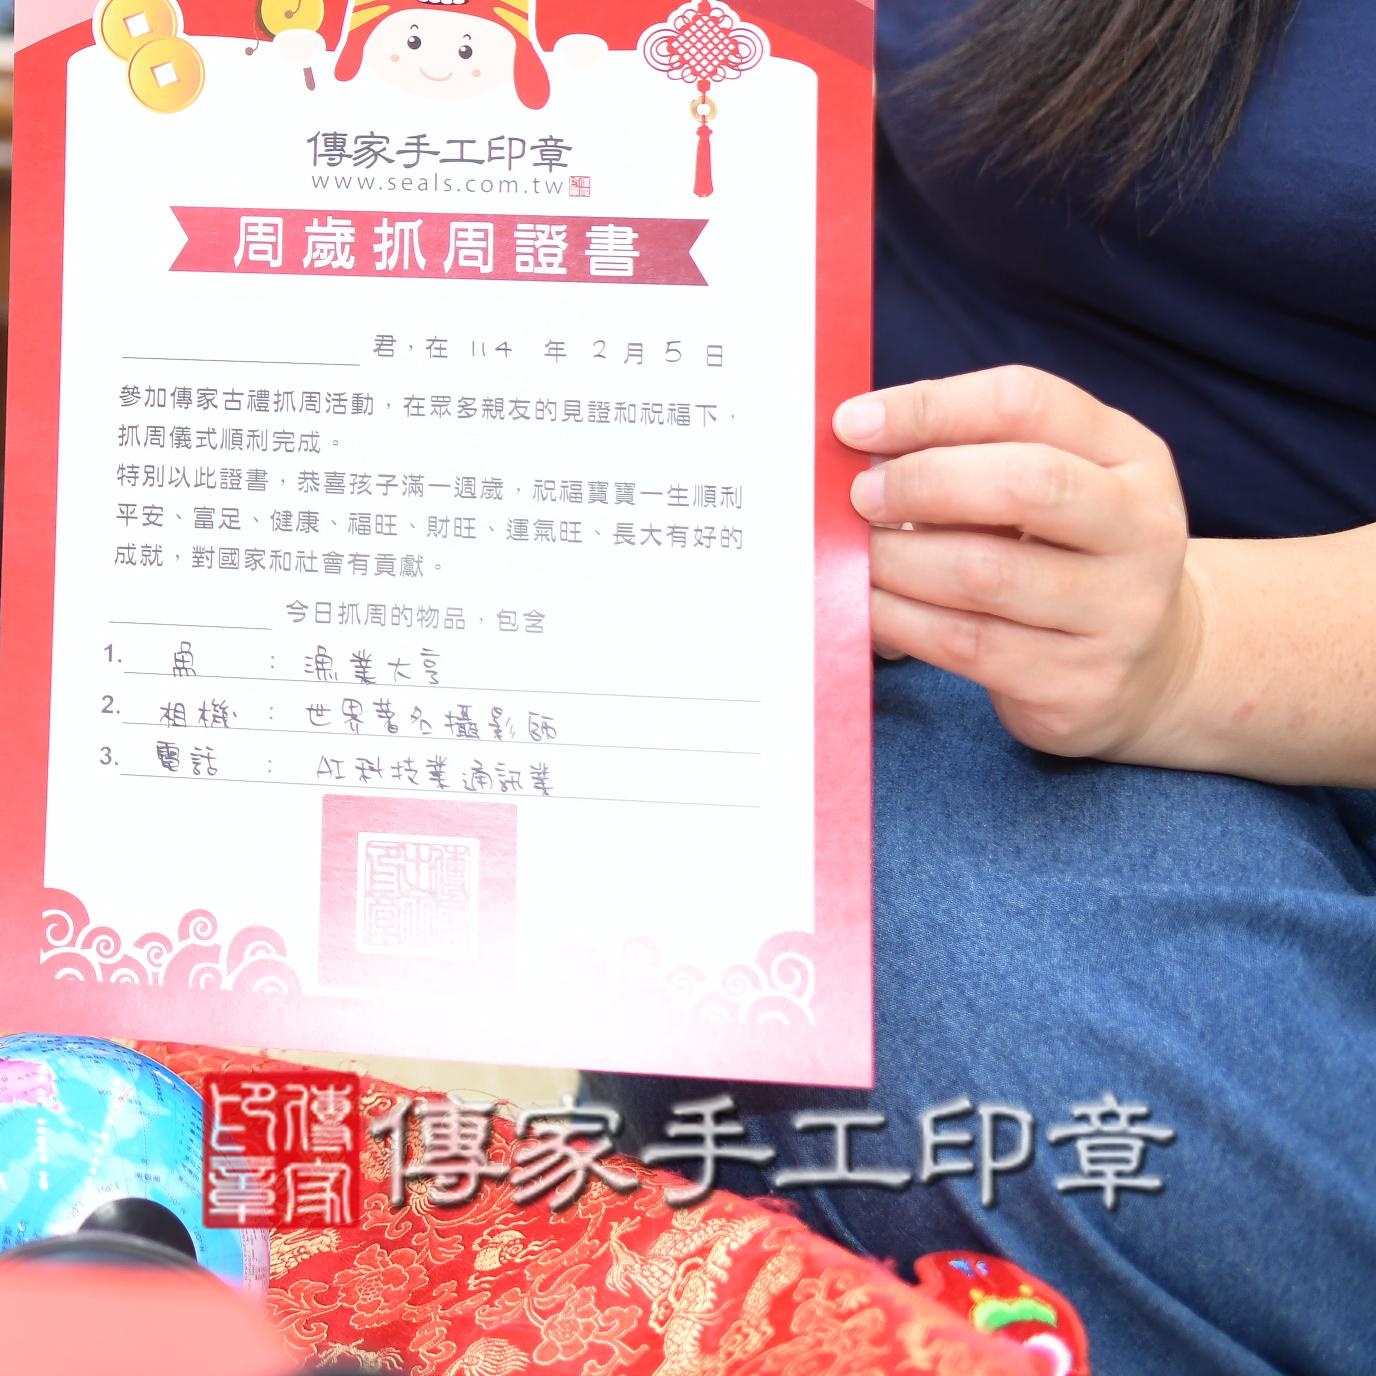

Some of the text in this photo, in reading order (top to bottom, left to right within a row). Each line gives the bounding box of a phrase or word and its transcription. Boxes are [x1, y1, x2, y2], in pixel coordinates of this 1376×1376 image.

[306, 130, 573, 173] 傳家手工印章
[311, 172, 564, 194] www.seals.com.tw
[232, 214, 641, 278] 周歲抓周證書
[472, 341, 512, 358] 114
[544, 339, 566, 363] 年
[593, 340, 606, 358] 2
[624, 343, 643, 365] 月
[665, 341, 681, 362] 5
[707, 345, 722, 367] 日
[104, 644, 121, 663] 1.
[101, 695, 120, 714] 2.
[100, 747, 118, 765] 3.
[156, 741, 217, 776] 電話
